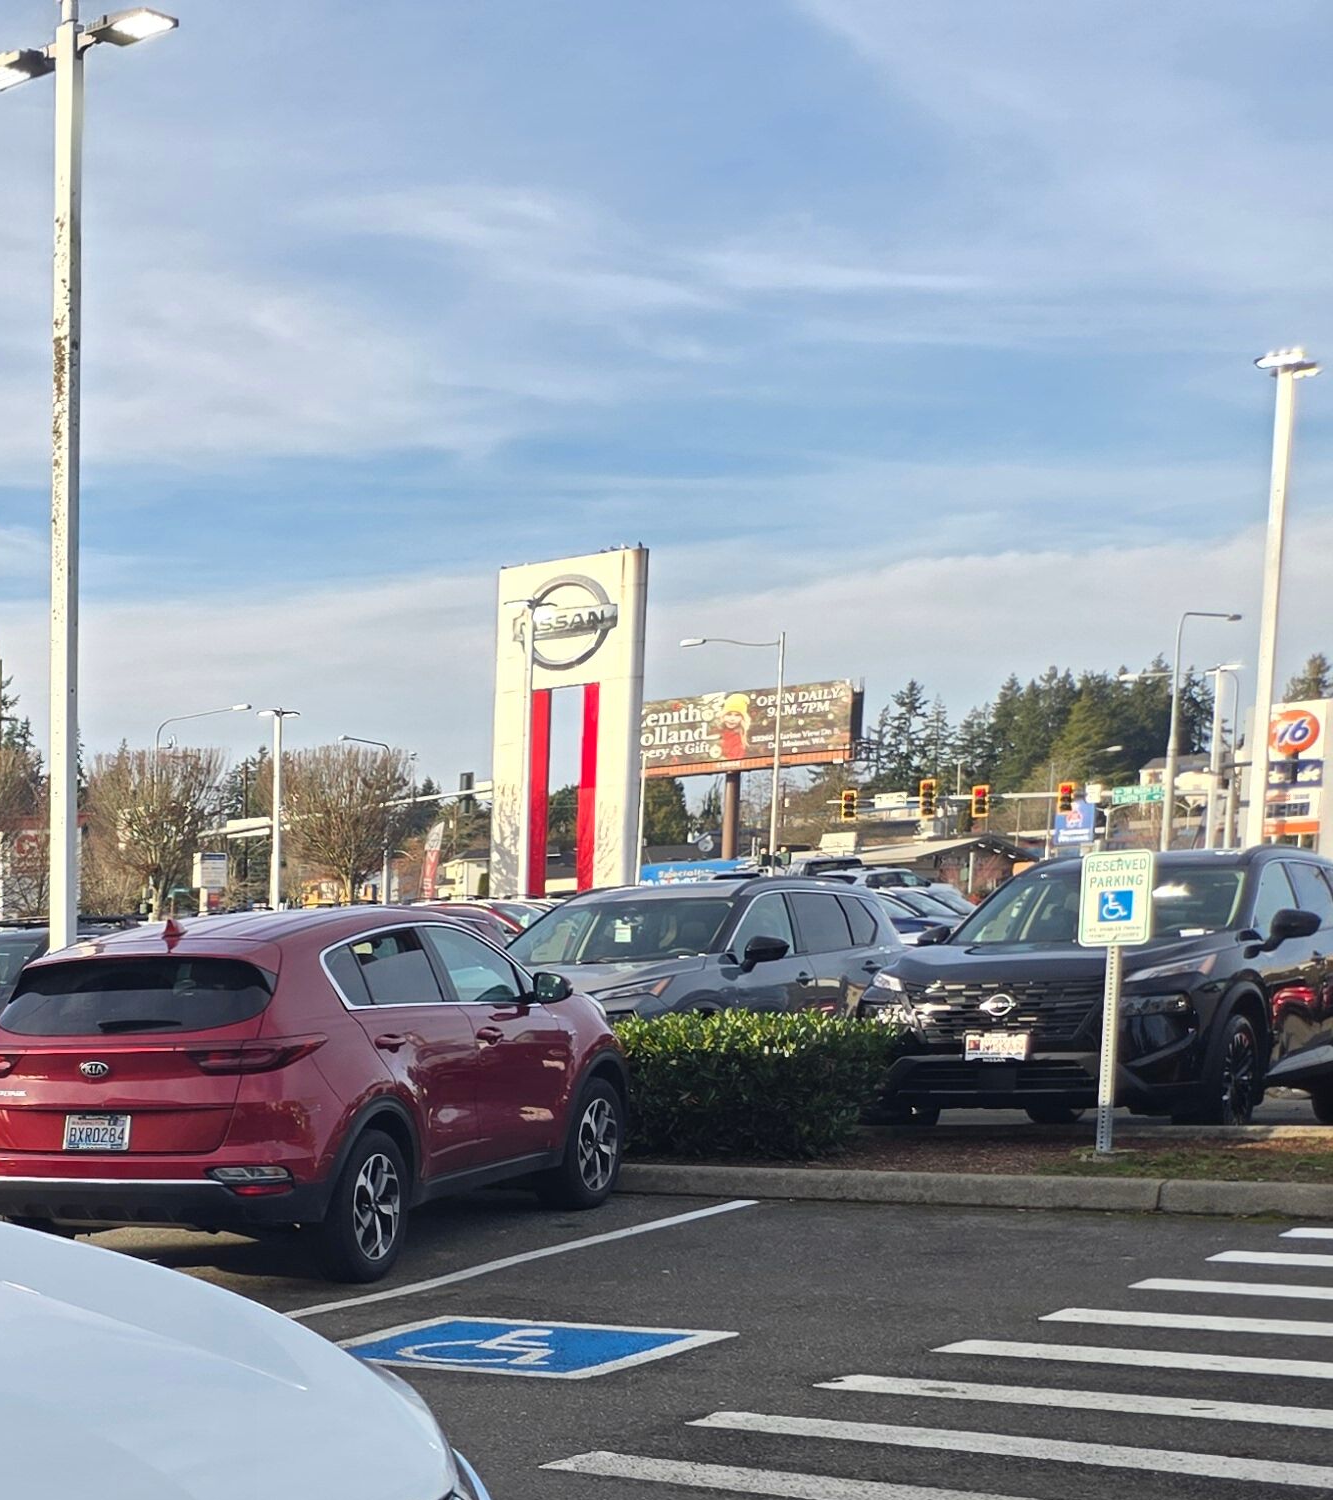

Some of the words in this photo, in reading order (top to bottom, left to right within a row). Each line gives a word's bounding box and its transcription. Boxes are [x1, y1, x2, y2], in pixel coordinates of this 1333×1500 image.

[520, 609, 605, 634] ISSAN
[798, 688, 841, 703] DAILY
[640, 722, 708, 746] olland
[671, 745, 683, 755] &
[1088, 858, 1147, 872] RESERVED
[1090, 874, 1144, 888] PARKING
[84, 1064, 103, 1074] KIA
